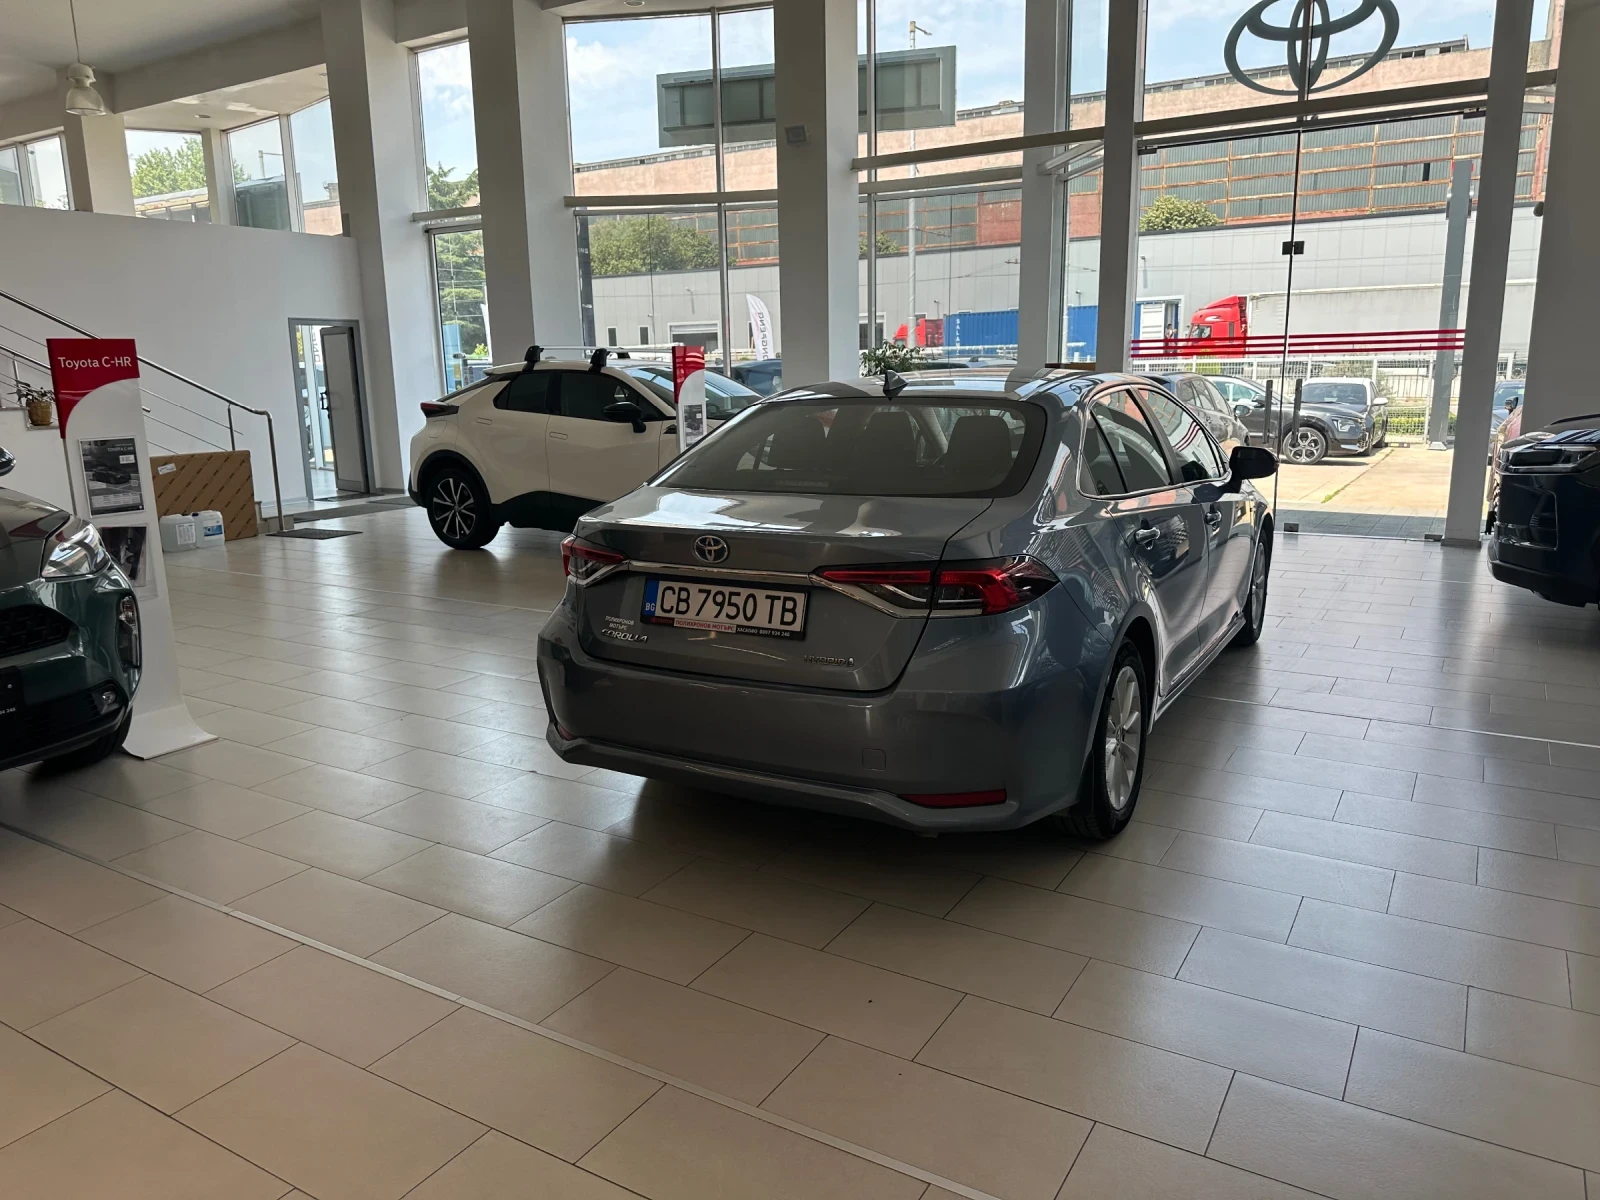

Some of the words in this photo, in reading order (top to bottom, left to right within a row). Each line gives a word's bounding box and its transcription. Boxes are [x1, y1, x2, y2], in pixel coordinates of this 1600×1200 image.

[57, 356, 100, 371] Toyota
[101, 356, 132, 367] C-HR
[645, 603, 656, 612] BG
[660, 586, 691, 615] CB
[695, 588, 758, 622] 7950
[765, 594, 798, 627] TB
[675, 619, 711, 629] ПОЛИХРОНОВ
[712, 623, 735, 631] МОТЪРС
[601, 628, 648, 643] COROLLA
